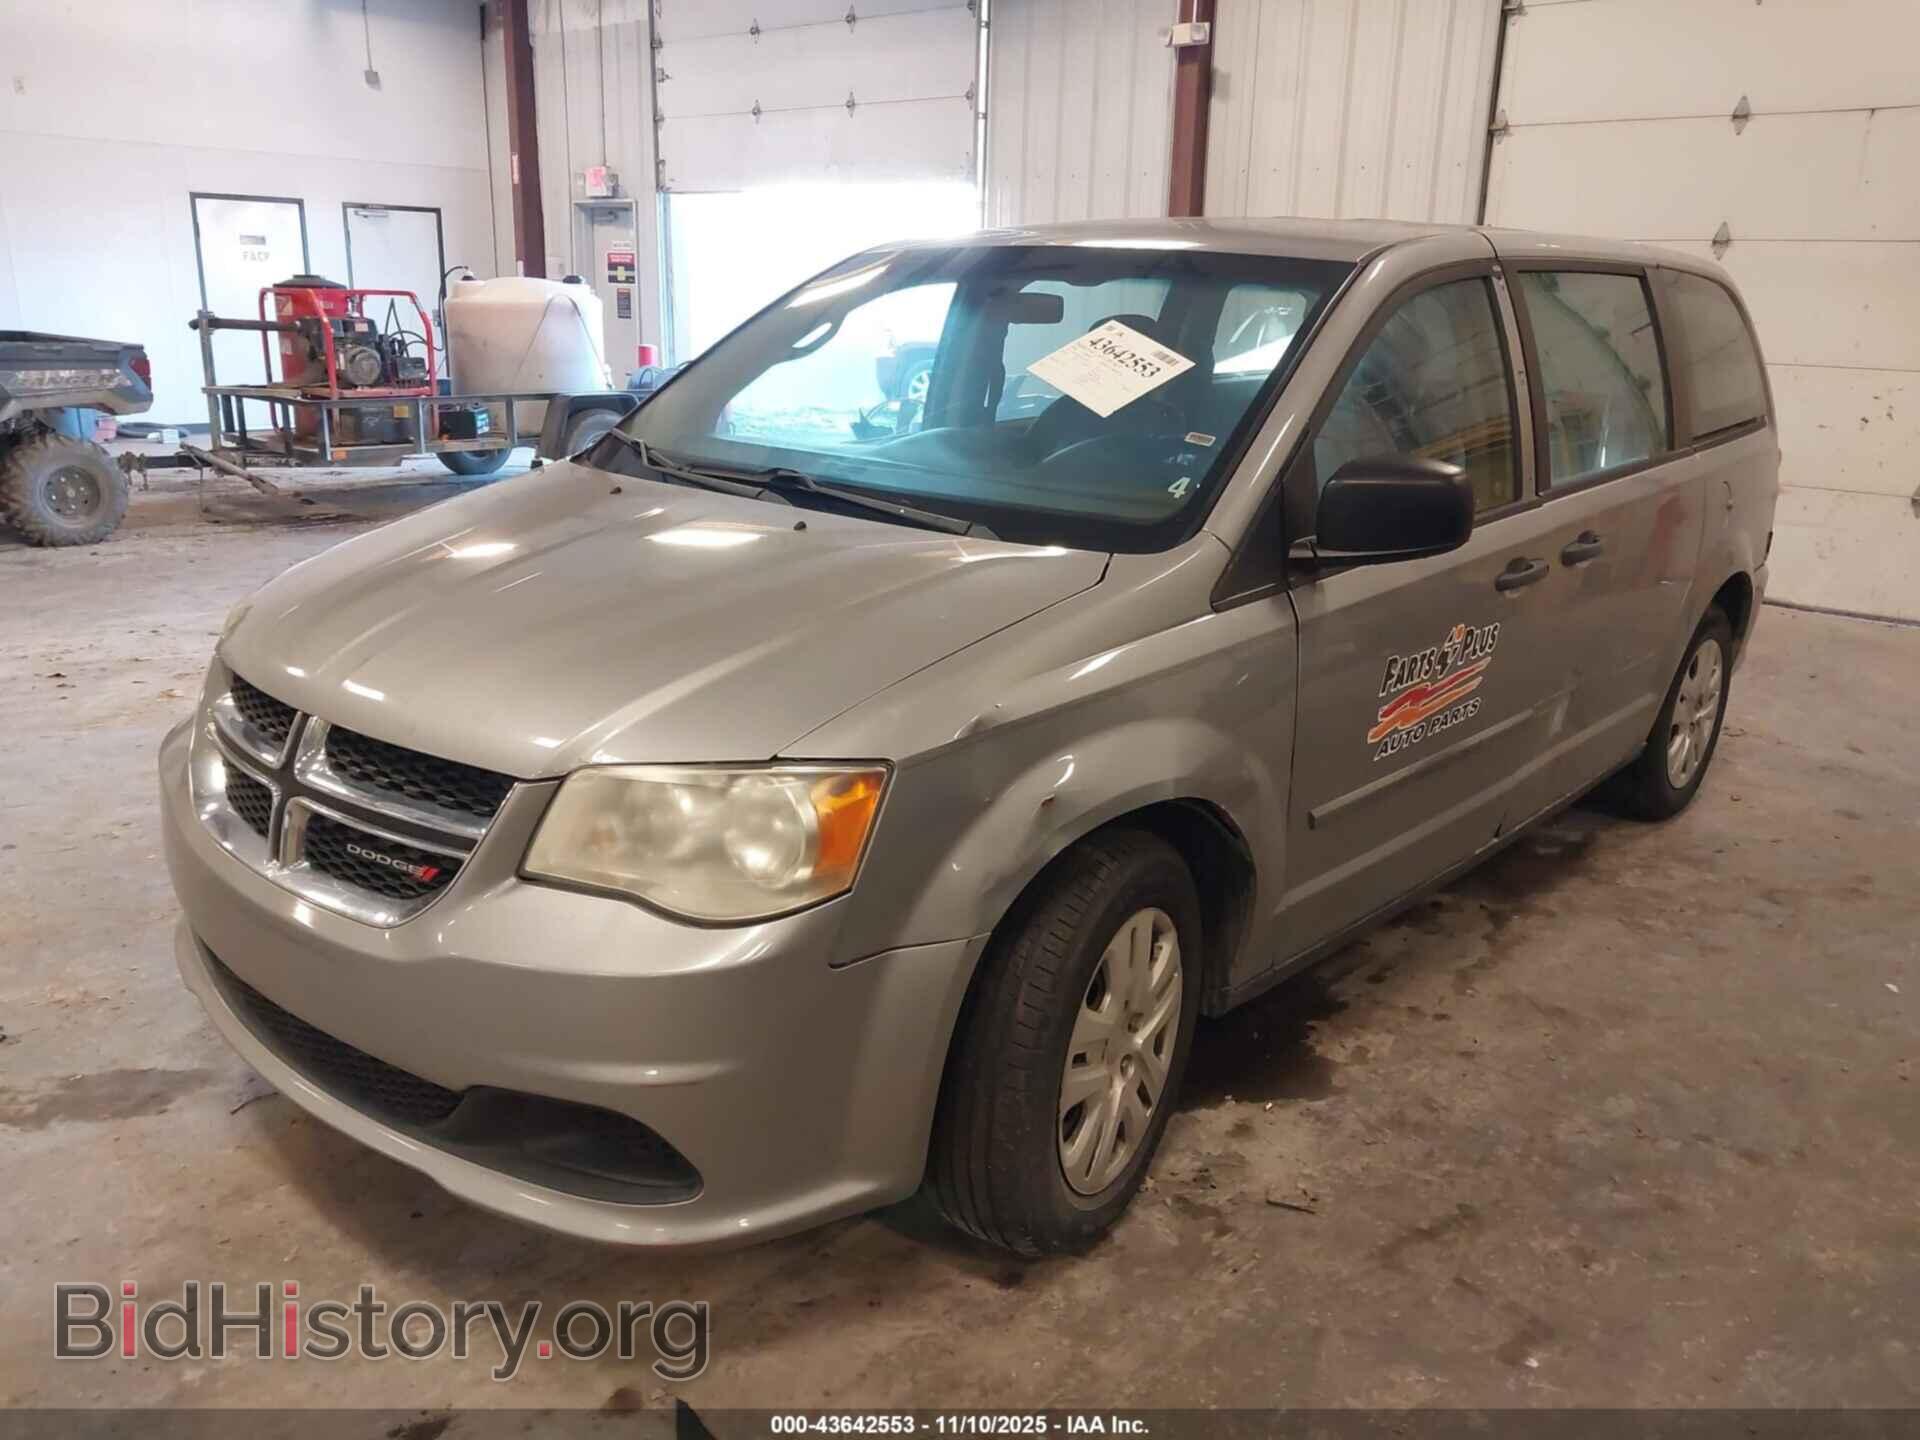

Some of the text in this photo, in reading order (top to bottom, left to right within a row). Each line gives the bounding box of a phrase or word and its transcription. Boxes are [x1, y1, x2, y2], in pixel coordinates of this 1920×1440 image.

[1088, 337, 1161, 378] 43642553
[1167, 476, 1191, 499] 4
[1457, 622, 1500, 665] PLUS
[1374, 696, 1481, 761] AUTO PARTS
[346, 843, 424, 876] DODGE
